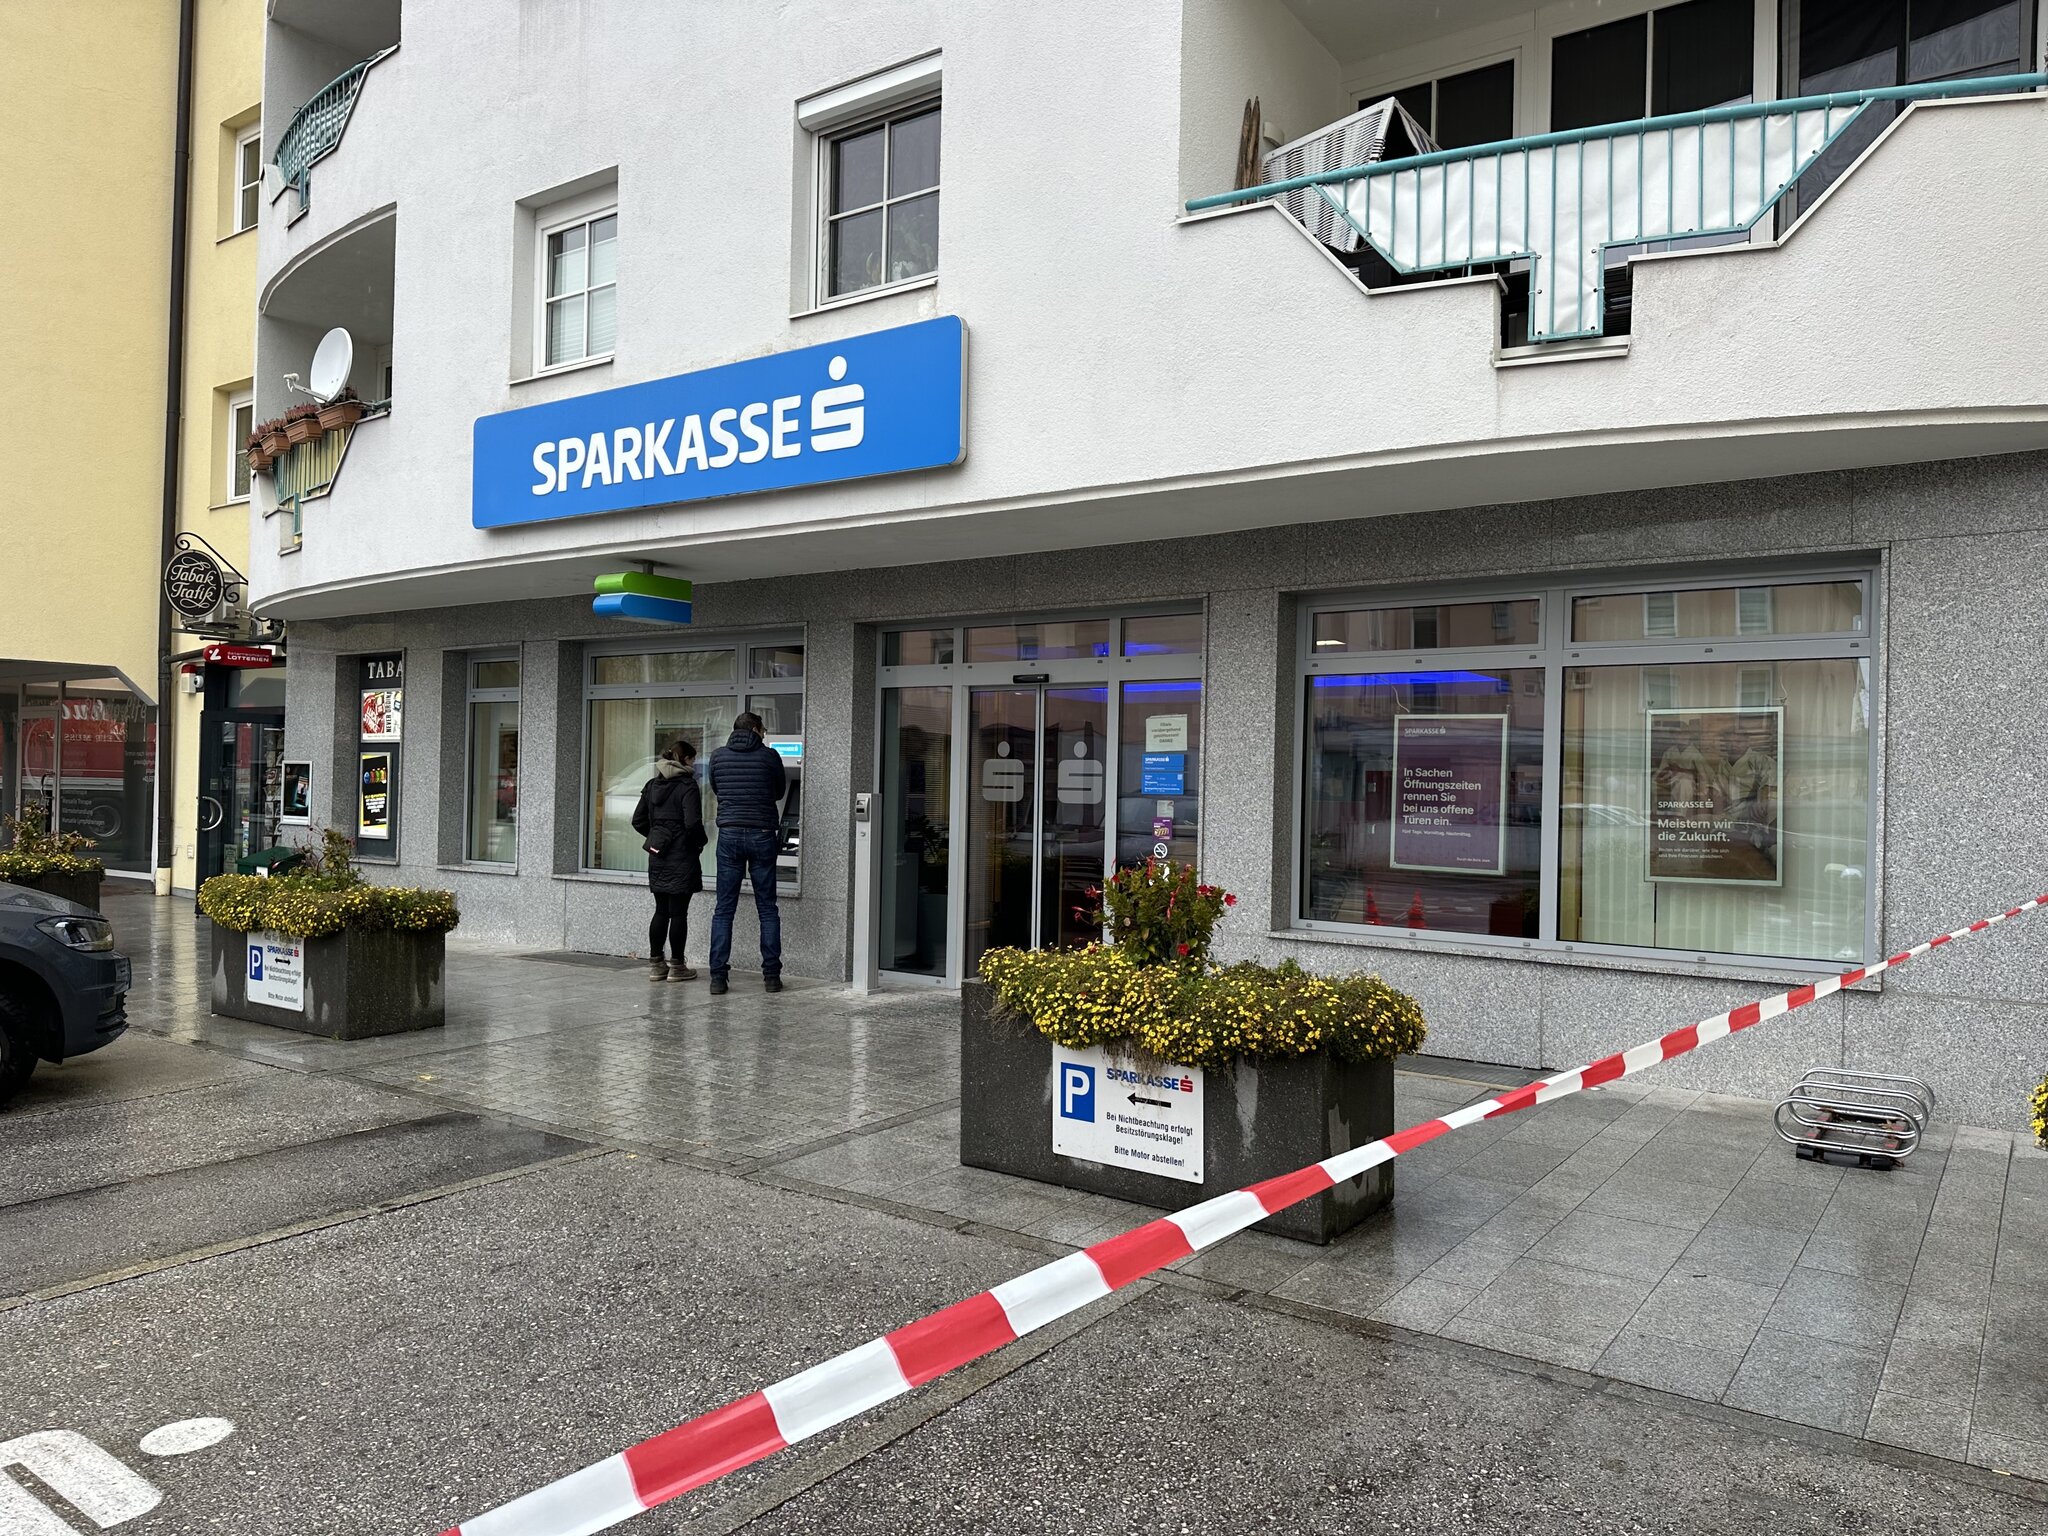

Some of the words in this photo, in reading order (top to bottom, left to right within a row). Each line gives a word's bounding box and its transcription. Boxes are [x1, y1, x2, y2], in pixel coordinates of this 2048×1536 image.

[531, 394, 802, 496] SPARKASSE
[170, 564, 217, 586] Tabak
[170, 581, 217, 602] Trafik
[227, 655, 270, 663] LOTTERIEN
[1403, 767, 1413, 777] In
[1415, 768, 1453, 778] Sachen
[1403, 777, 1482, 791] Öffnungszeiten
[1403, 792, 1438, 802] rennen
[1440, 792, 1457, 802] Sie
[1403, 803, 1418, 813] bei
[1420, 805, 1439, 814] uns
[1440, 804, 1474, 815] offene
[1657, 800, 1704, 809] SPARKASSE
[1403, 814, 1432, 825] Türen
[1433, 816, 1452, 826] ein.
[1658, 818, 1710, 829] Meistern
[1713, 819, 1733, 829] wir
[1657, 831, 1676, 841] die
[1679, 831, 1731, 842] Zukunft.
[1106, 1067, 1180, 1091] SPARKASSE
[1106, 1111, 1117, 1121] Bei
[1118, 1114, 1169, 1132] Nichtbeachtung
[1170, 1125, 1193, 1137] erfolgt
[1115, 1124, 1183, 1145] Besitzstörungsklage!
[1114, 1145, 1129, 1156] Bitte
[1130, 1148, 1150, 1160] Motor
[1151, 1153, 1185, 1168] abstellen!
